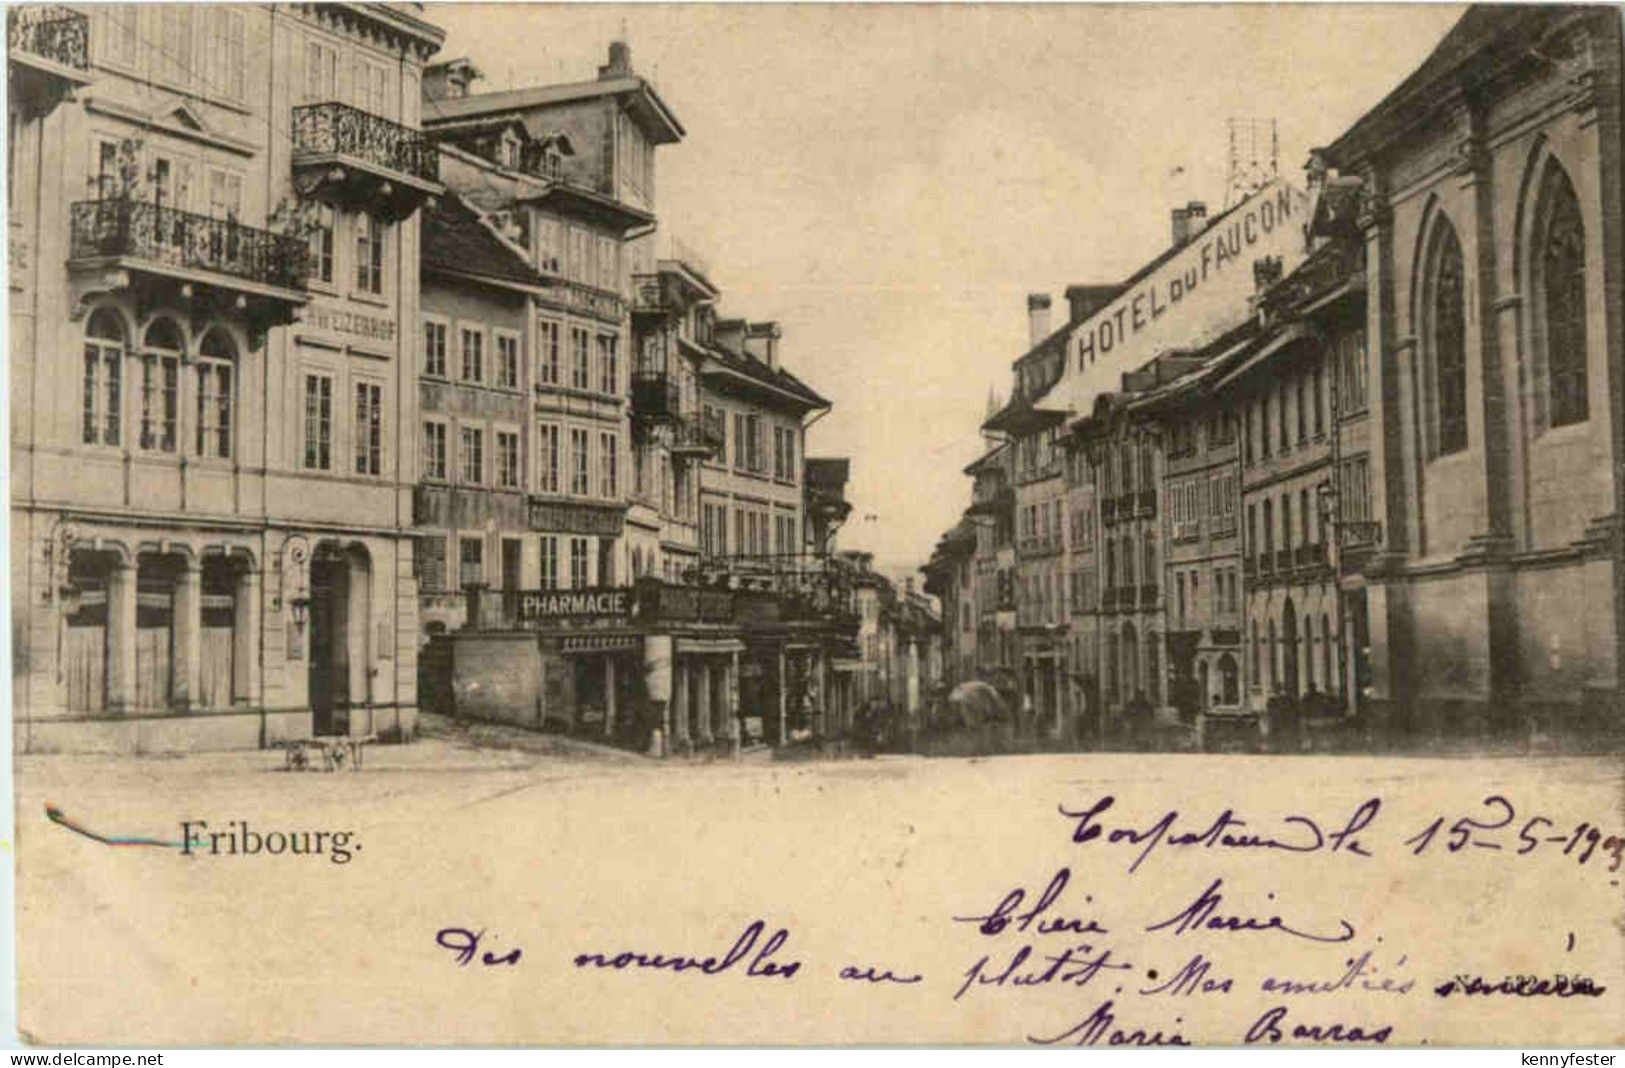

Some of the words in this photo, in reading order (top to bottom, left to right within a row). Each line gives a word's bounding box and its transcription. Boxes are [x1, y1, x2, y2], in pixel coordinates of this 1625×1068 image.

[1079, 285, 1165, 372] HOTEL
[523, 593, 625, 616] PHARMACIE
[180, 821, 363, 864] Fribourg.
[1329, 798, 1382, 856] le
[436, 928, 523, 966] Des
[573, 920, 801, 977] nouvelles
